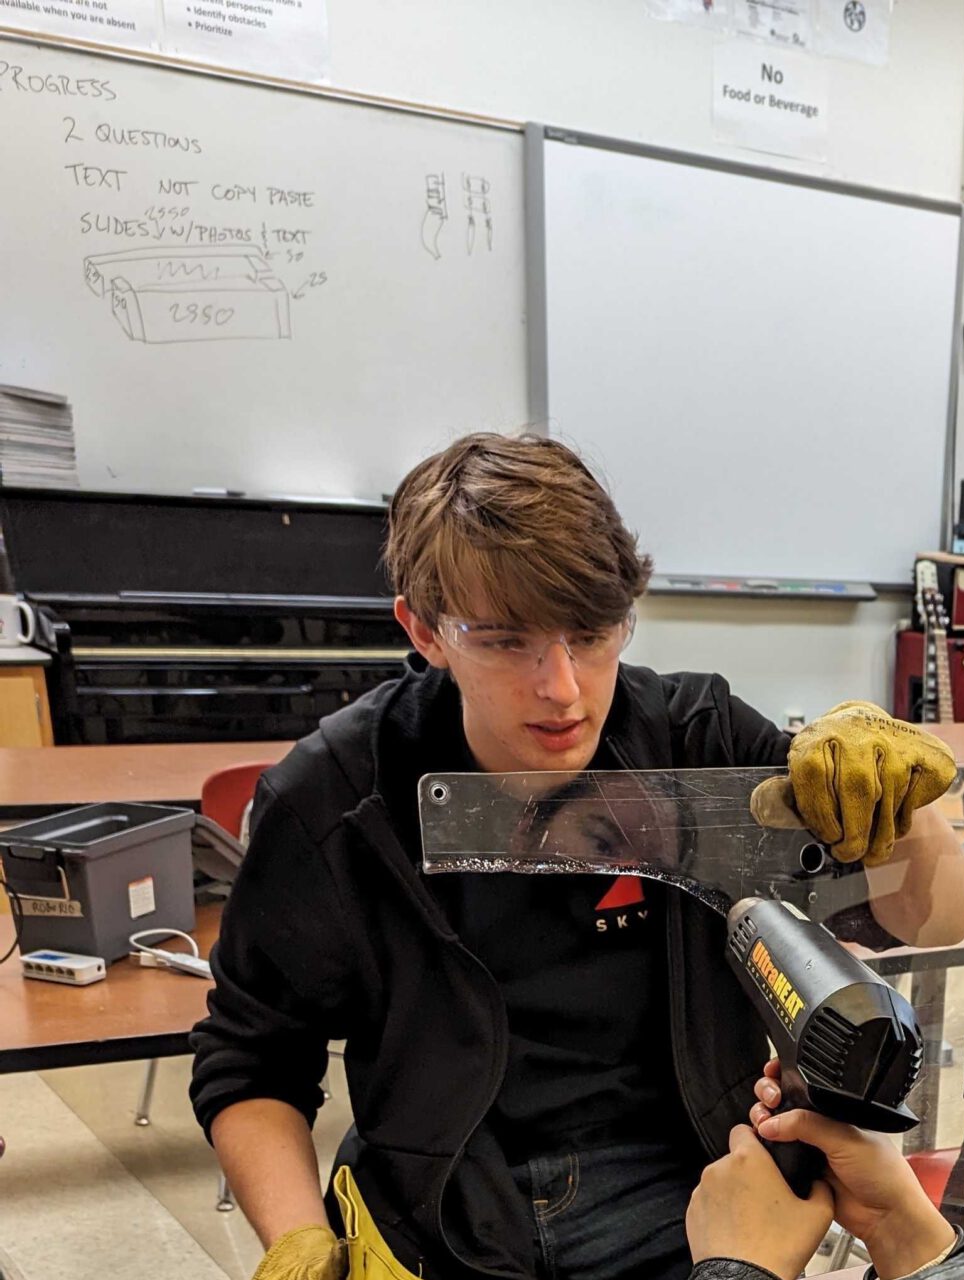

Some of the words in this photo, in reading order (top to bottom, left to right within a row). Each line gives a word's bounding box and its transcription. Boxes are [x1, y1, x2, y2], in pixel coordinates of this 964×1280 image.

[42, 5, 68, 17] when
[71, 10, 87, 20] you
[89, 14, 104, 23] are
[106, 17, 136, 31] absent
[92, 1, 108, 10] not
[193, 6, 226, 22] Identify
[228, 14, 267, 29] obstacles
[194, 20, 233, 36] Prioritize
[760, 62, 784, 85] No
[722, 84, 751, 102] Food
[753, 93, 766, 106] or
[768, 95, 819, 118] Beverage
[63, 116, 84, 143] 2
[95, 123, 202, 154] QUESTIONS
[64, 162, 128, 192] TEXT
[158, 179, 198, 197] NOT
[211, 184, 257, 203] COPY
[268, 187, 316, 208] PASTE
[81, 212, 150, 238] SLIDES
[272, 229, 312, 245] TEXT
[746, 960, 760, 979] HOT
[761, 982, 773, 1000] AIR
[775, 1003, 793, 1031] TOOL
[751, 940, 806, 1021] UltraHEAT
